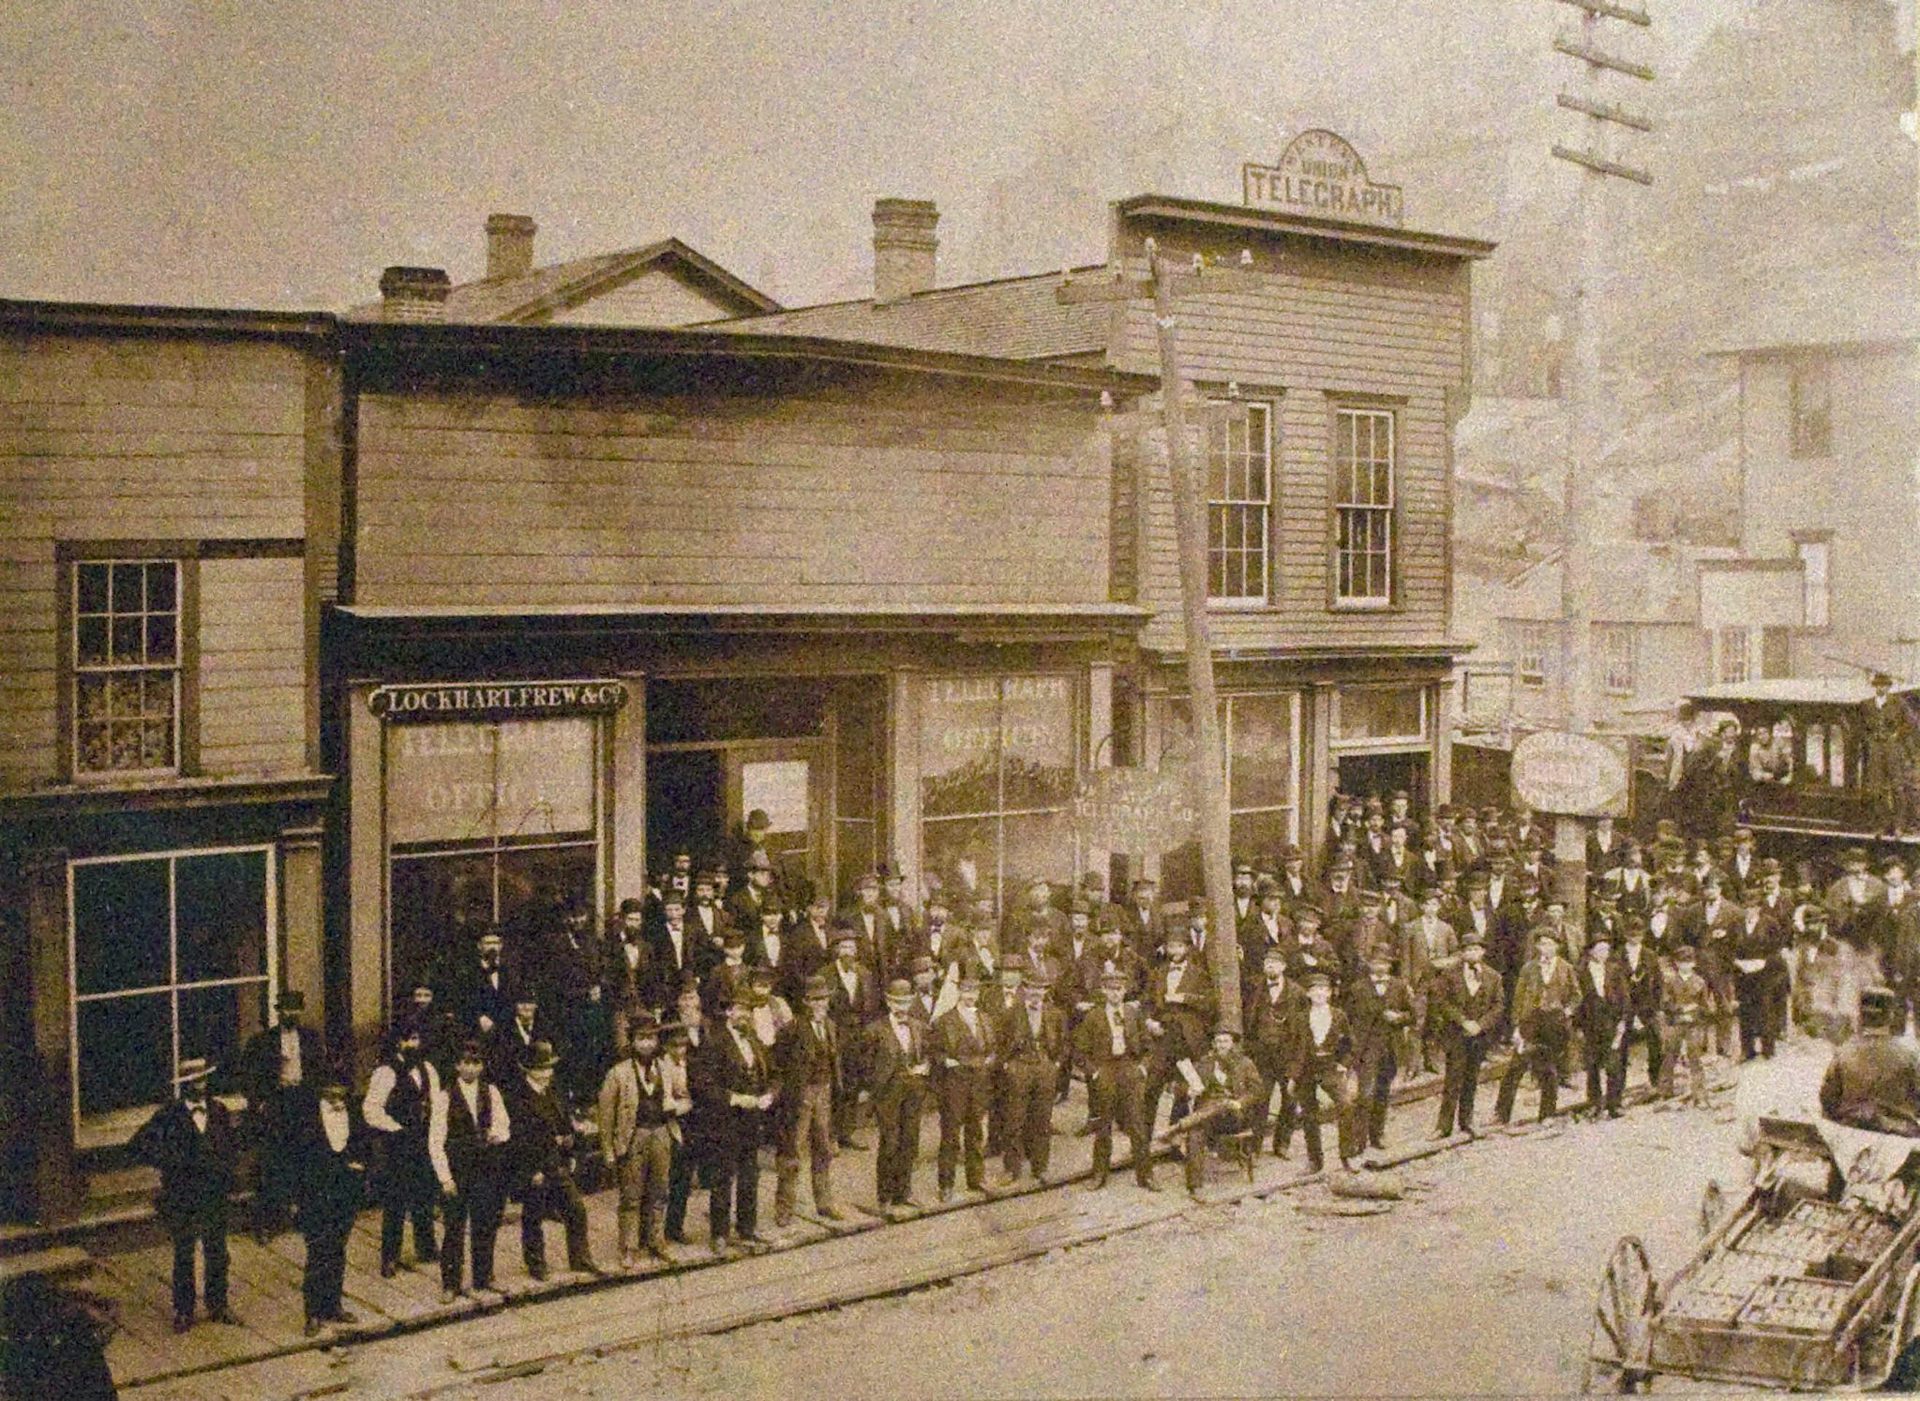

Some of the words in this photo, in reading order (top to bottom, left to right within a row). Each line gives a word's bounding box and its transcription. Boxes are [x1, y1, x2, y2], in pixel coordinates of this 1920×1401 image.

[1301, 159, 1348, 179] UNION
[1249, 171, 1392, 216] TELEGRAPH
[519, 686, 578, 707] FREW
[580, 686, 598, 705] &
